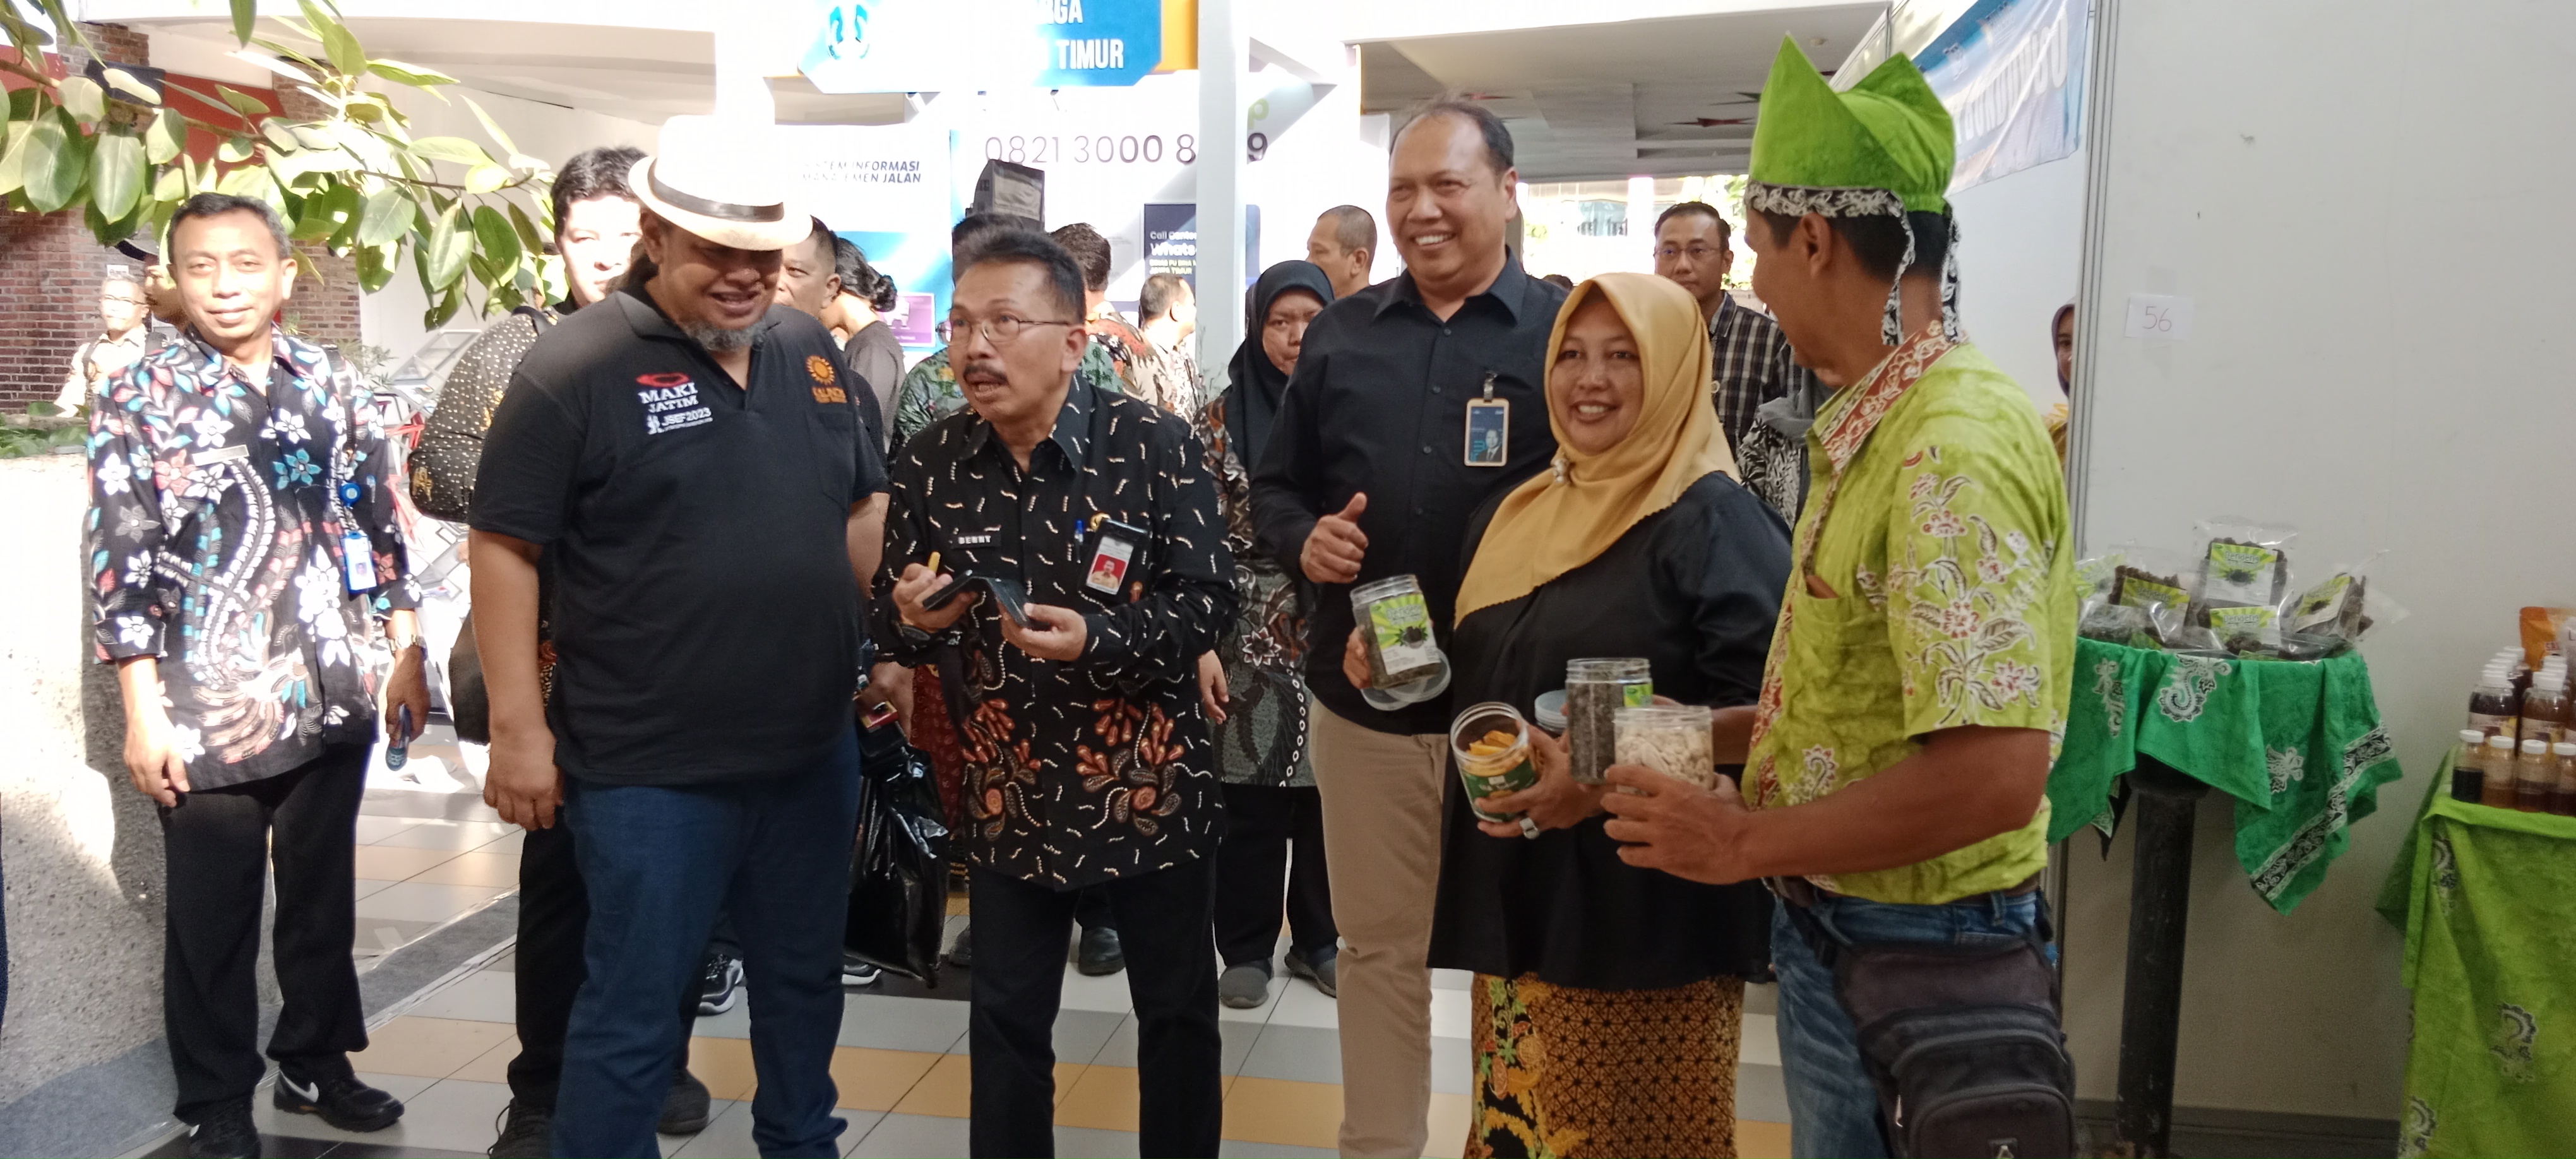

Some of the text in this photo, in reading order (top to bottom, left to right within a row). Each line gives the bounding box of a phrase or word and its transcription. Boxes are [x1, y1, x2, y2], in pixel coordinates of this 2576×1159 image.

[1042, 0, 1083, 25] RGA
[1055, 38, 1124, 70] TIMUR
[985, 135, 1059, 163] 0821
[1074, 134, 1163, 163] 3000
[852, 160, 920, 172] INFORMASI
[883, 172, 921, 183] JALAN
[1150, 230, 1167, 240] Call
[1150, 242, 1197, 256] Whats
[2142, 306, 2172, 332] 56
[637, 382, 698, 404] MAKI
[648, 395, 699, 413] JATIM
